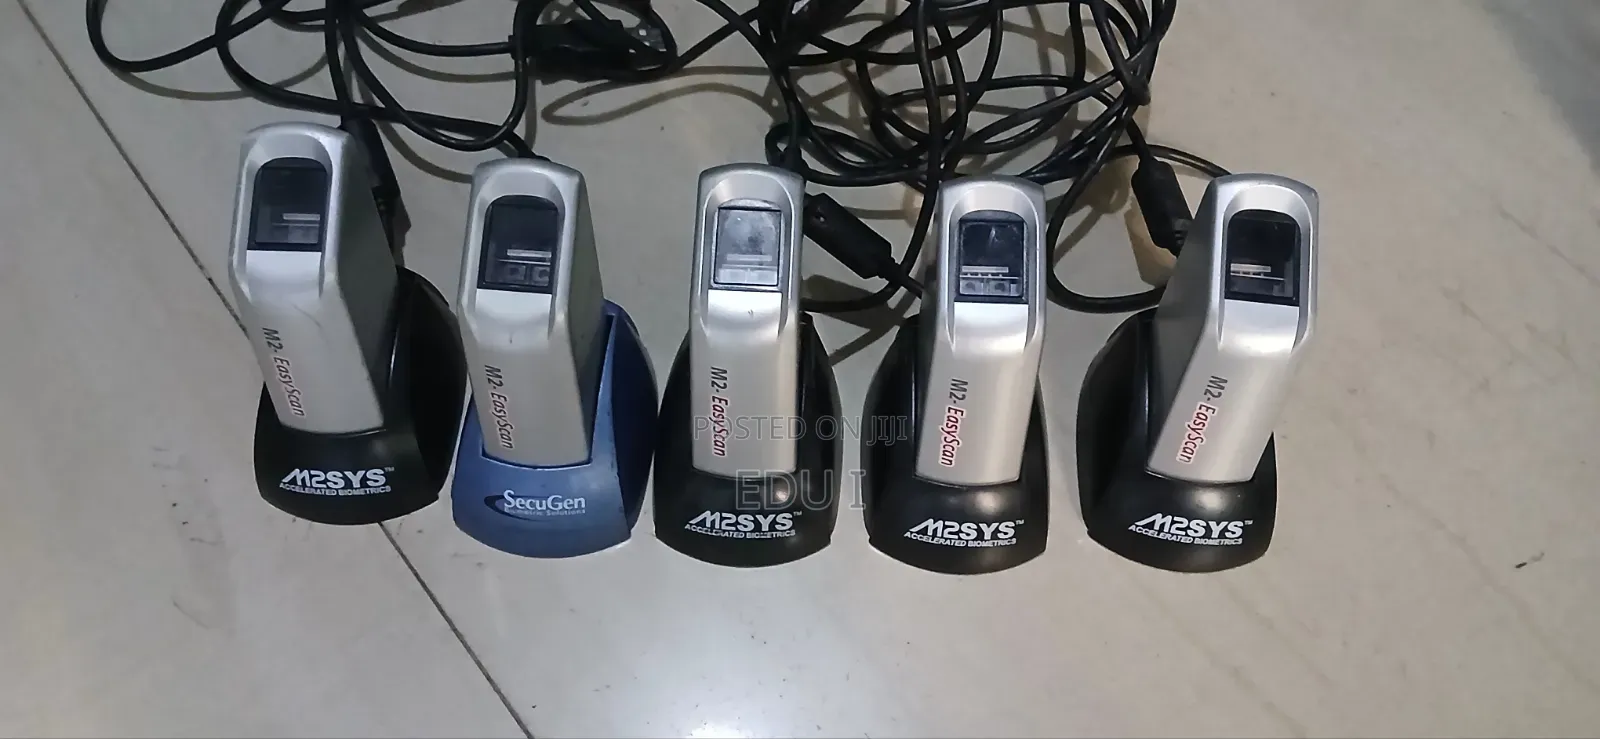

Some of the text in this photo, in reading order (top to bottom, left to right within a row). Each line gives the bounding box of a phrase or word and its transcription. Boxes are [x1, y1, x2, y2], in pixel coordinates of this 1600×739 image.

[273, 356, 305, 417] EasyScan
[491, 391, 514, 449] EasyScan
[708, 396, 729, 457] EasyScan
[940, 406, 965, 466] EasyScan
[1179, 403, 1216, 463] EasyScan
[279, 482, 391, 496] ACCELERATED BIOMETRICS
[503, 489, 586, 511] SecuGen
[904, 531, 1017, 548] ACCELERATED BIOMETRICS
[1128, 524, 1243, 546] ACCELERATED BIOMETRICS
